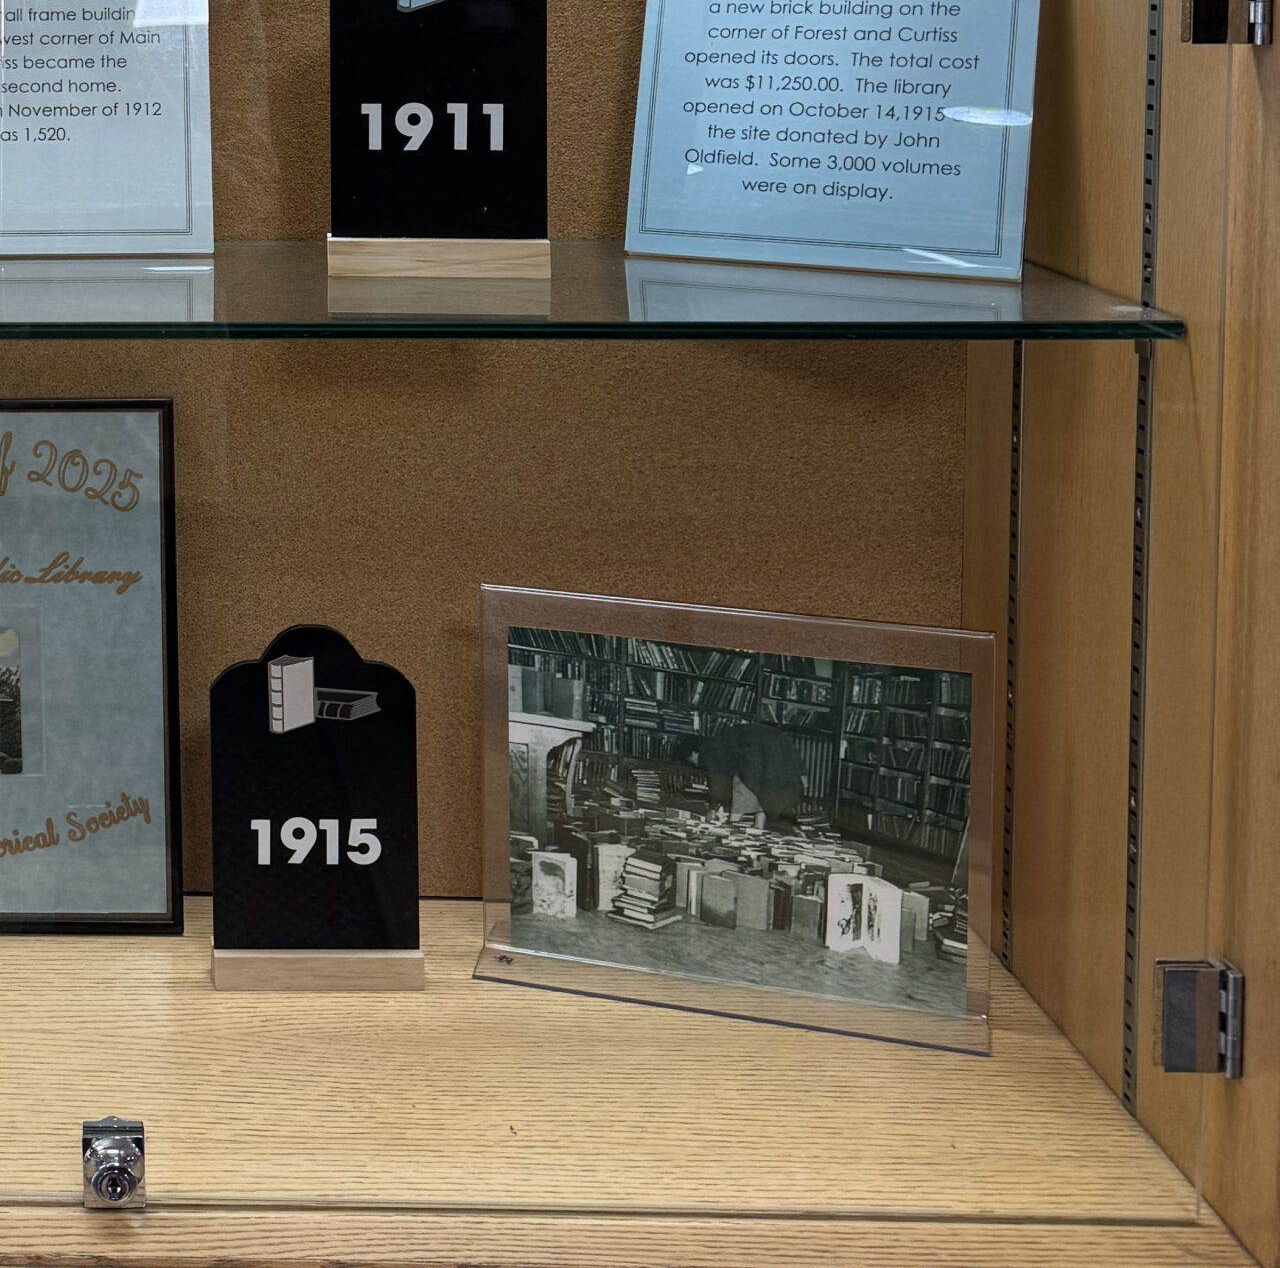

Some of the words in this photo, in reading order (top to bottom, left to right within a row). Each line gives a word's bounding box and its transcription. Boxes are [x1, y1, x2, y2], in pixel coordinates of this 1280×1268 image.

[28, 8, 77, 21] frame
[82, 7, 144, 23] buildin
[708, 28, 767, 39] corner
[771, 25, 790, 40] of
[795, 26, 848, 40] Forest
[854, 27, 892, 41] and
[898, 27, 957, 43] Curtiss
[23, 56, 95, 69] became
[101, 54, 127, 68] the
[685, 50, 756, 66] opened
[761, 50, 779, 65] its
[784, 51, 838, 66] doors.
[851, 52, 883, 67] The
[889, 53, 933, 68] total
[939, 55, 980, 69] cost
[1, 79, 63, 93] second
[68, 79, 122, 93] home.
[705, 77, 740, 90] was
[745, 75, 844, 93] $11,250.00.
[856, 78, 888, 93] The
[894, 79, 951, 99] library
[9, 103, 97, 117] November
[102, 102, 119, 116] of
[125, 102, 162, 116] 1912
[683, 100, 754, 116] opened
[760, 104, 783, 116] on
[789, 102, 869, 118] October
[877, 105, 946, 121] 14,1915
[25, 127, 71, 142] 1,520.
[360, 103, 505, 151] 1911
[685, 148, 758, 166] Oldfield.
[769, 152, 821, 169] Some
[827, 155, 876, 171] 3,000
[881, 158, 960, 176] volumes
[742, 180, 788, 193] were
[793, 183, 816, 195] on
[823, 181, 893, 202] display.
[27, 440, 144, 512] 2025
[24, 551, 144, 595] Library
[66, 792, 151, 841] Society
[250, 817, 382, 866] 1915
